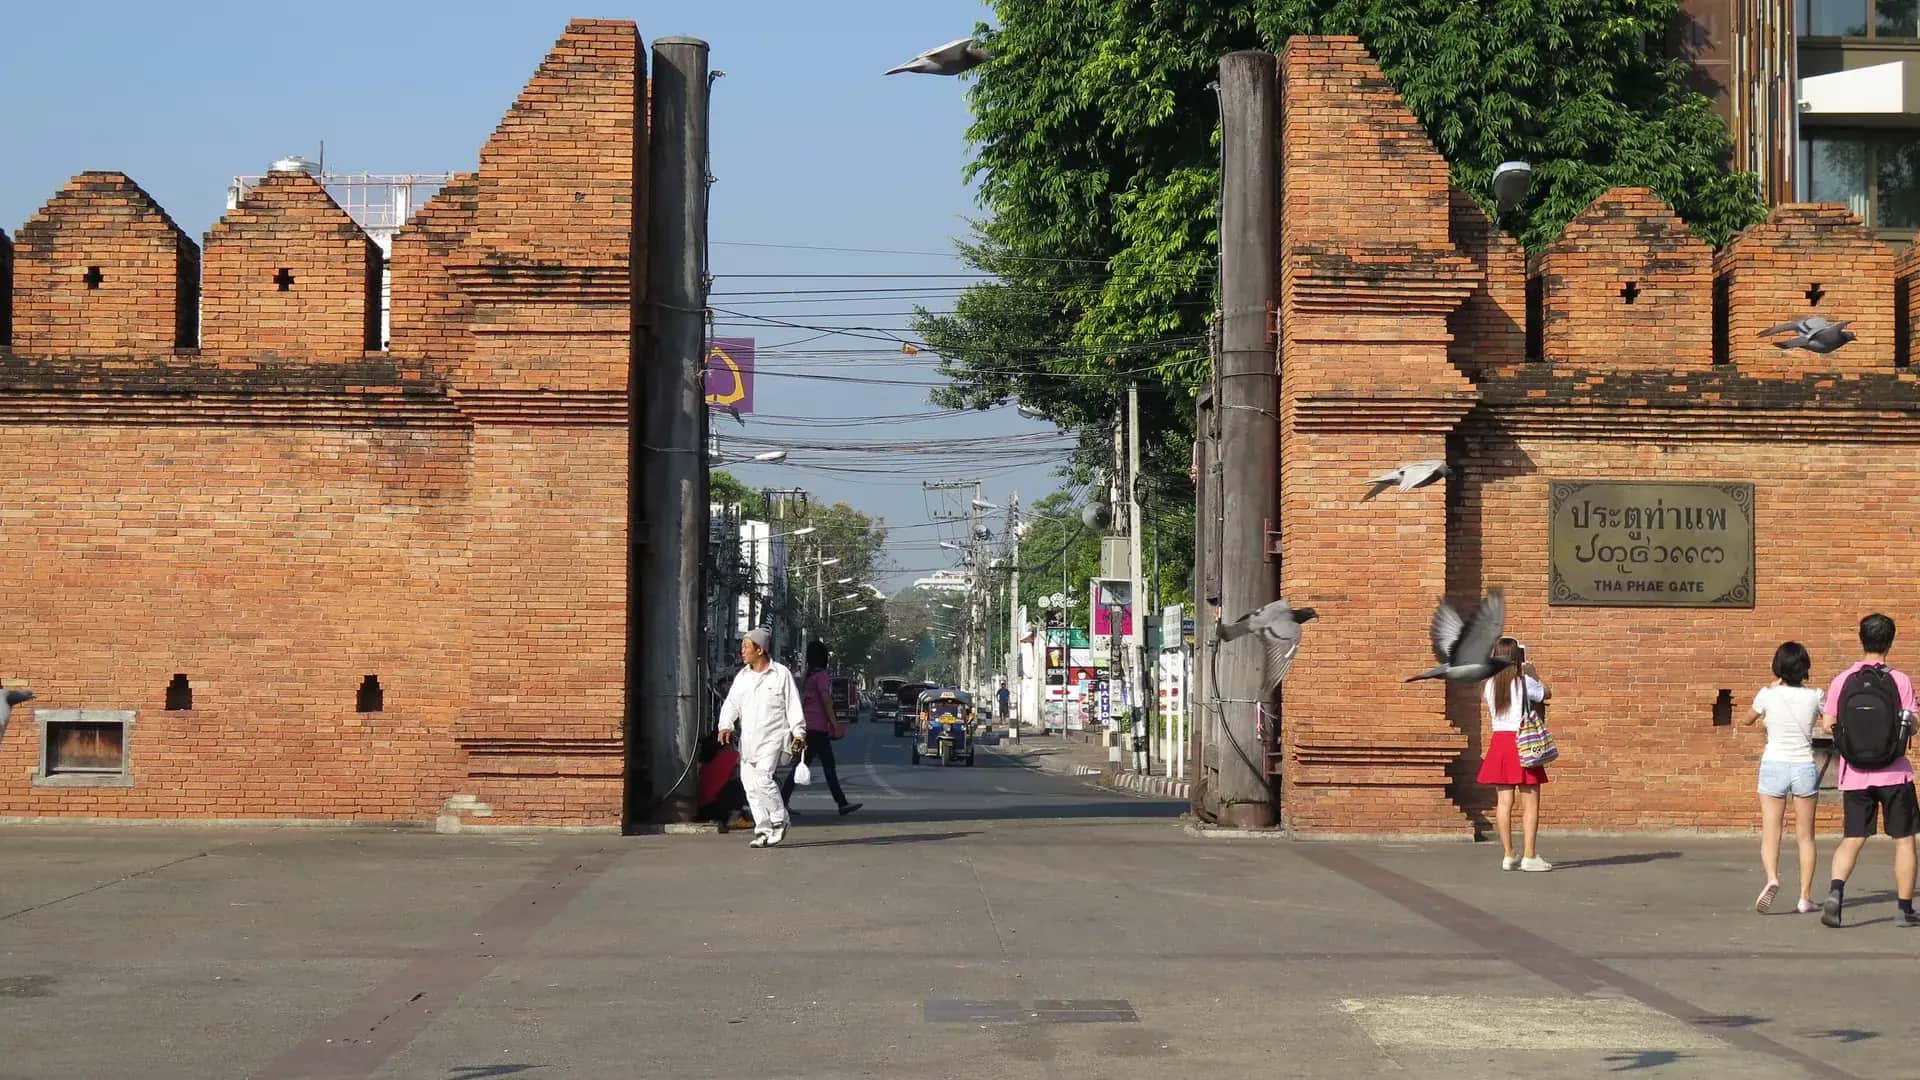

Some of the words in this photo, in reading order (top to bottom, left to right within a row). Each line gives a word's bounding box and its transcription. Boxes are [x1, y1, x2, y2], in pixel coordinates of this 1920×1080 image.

[1571, 499, 1727, 540] ประตูท่าแพ
[1594, 580, 1622, 592] THA
[1627, 581, 1664, 592] PHAE
[1669, 581, 1704, 593] GATE
[1099, 681, 1109, 725] TATTOO
